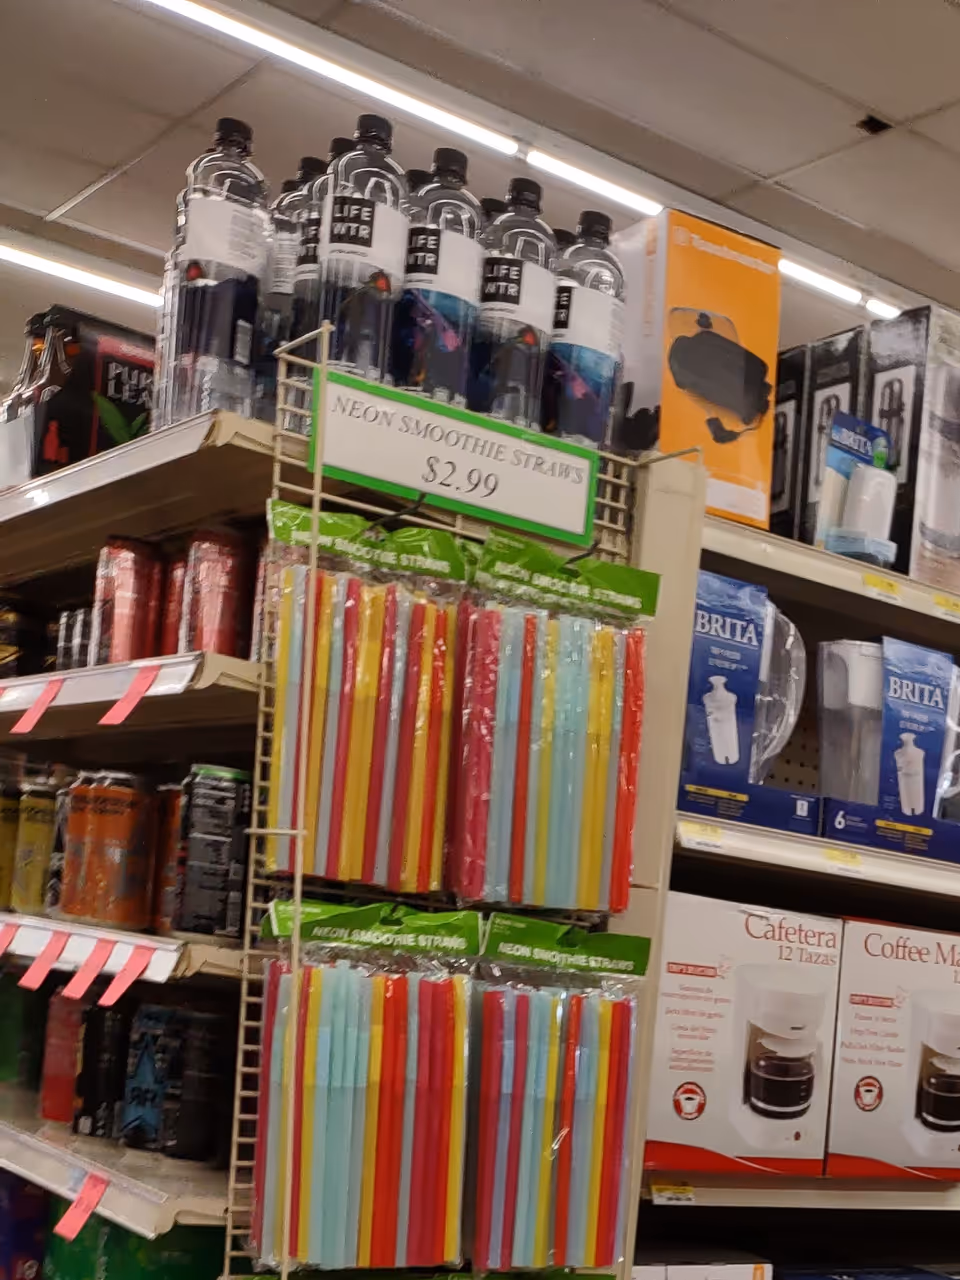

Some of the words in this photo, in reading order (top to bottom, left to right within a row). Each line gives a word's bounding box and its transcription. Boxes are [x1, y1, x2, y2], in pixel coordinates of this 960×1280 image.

[333, 204, 372, 222] LIFE
[332, 222, 371, 240] WTR
[409, 234, 438, 249] IFE
[408, 252, 438, 267] TR
[331, 394, 396, 428] NEON
[397, 414, 507, 462] SMOOTHIE
[510, 449, 585, 484] STRAWS
[420, 455, 500, 499] $2.99
[695, 608, 758, 646] BRITA
[887, 675, 945, 709] BRITA
[833, 810, 846, 830] 6
[311, 926, 349, 941] NEON
[350, 928, 416, 947] SMOOTHIE
[417, 934, 468, 950] STRAWS
[744, 913, 838, 950] Cafetera
[497, 942, 532, 957] NEON
[777, 944, 793, 960] 12
[795, 946, 837, 967] Tazas
[864, 932, 931, 964] Coffee
